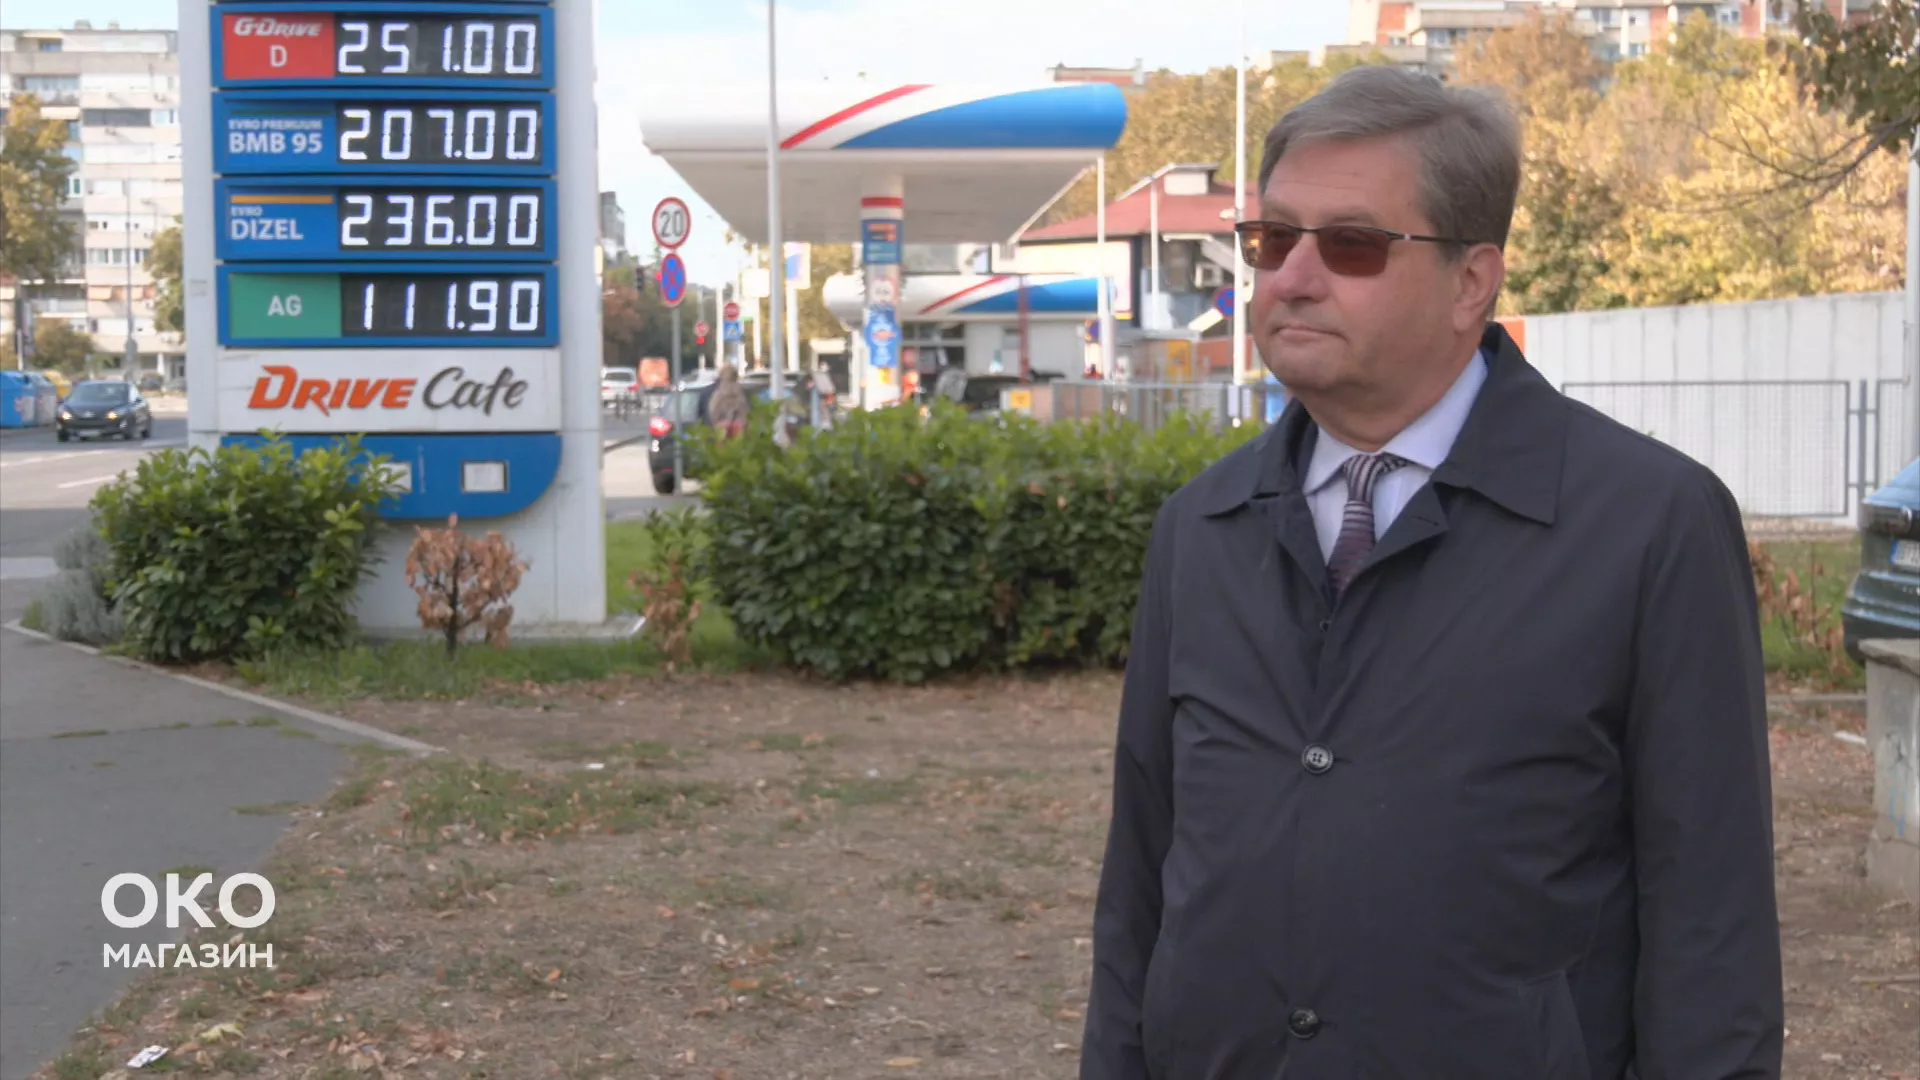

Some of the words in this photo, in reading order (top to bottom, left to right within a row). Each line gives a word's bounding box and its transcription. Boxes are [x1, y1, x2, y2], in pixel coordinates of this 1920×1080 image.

[270, 44, 288, 68] D
[338, 22, 536, 74] 251.00
[229, 132, 286, 153] BMB
[291, 132, 322, 153] 95
[340, 109, 537, 160] 207.00
[231, 219, 304, 240] DIZEL
[341, 195, 539, 246] 236.00
[660, 210, 684, 237] 20
[267, 295, 302, 317] AG
[363, 281, 540, 332] 111.90
[247, 365, 418, 417] DRIVE
[423, 366, 529, 416] Cafe
